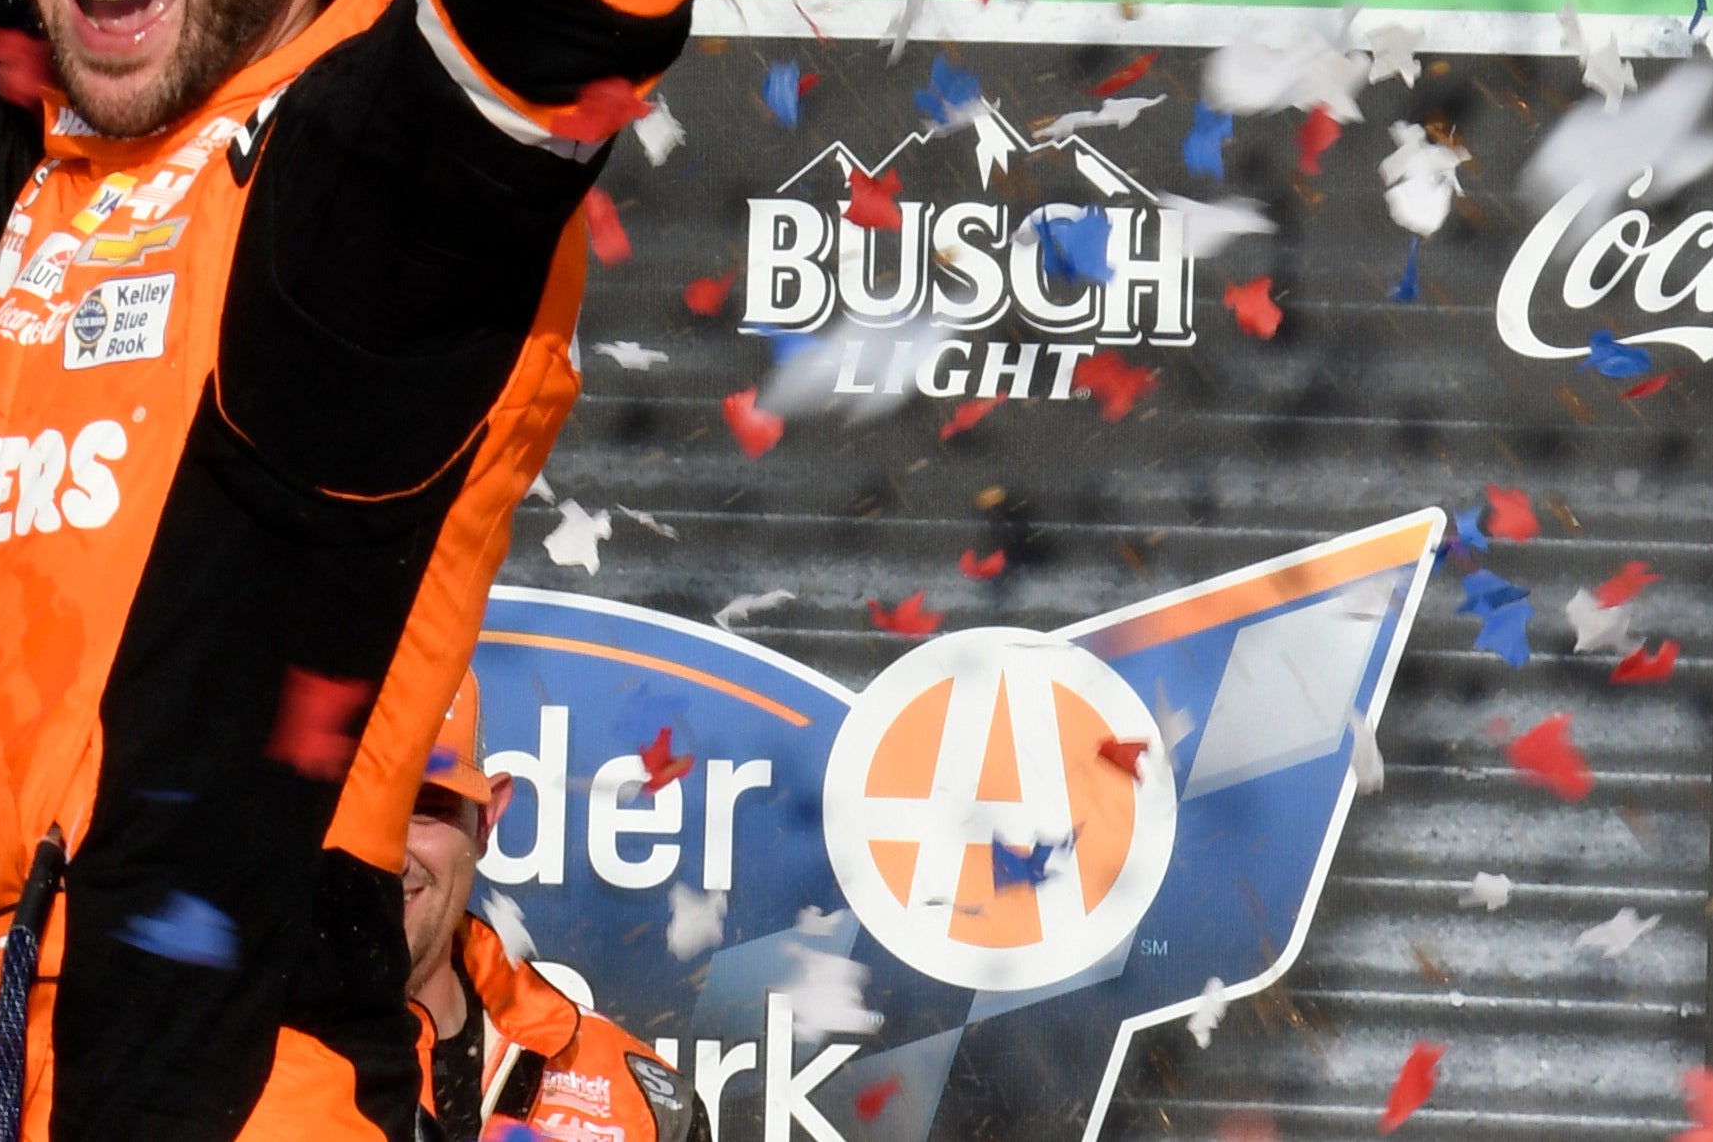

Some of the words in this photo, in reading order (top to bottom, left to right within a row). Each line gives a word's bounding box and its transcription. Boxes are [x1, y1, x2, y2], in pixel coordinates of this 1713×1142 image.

[737, 198, 1197, 346] BUSCH
[116, 282, 170, 309] Kelley
[113, 311, 149, 332] Blue
[105, 333, 148, 358] Book
[834, 339, 1094, 400] LIGHT
[476, 705, 772, 892] der
[1140, 939, 1169, 957] SM
